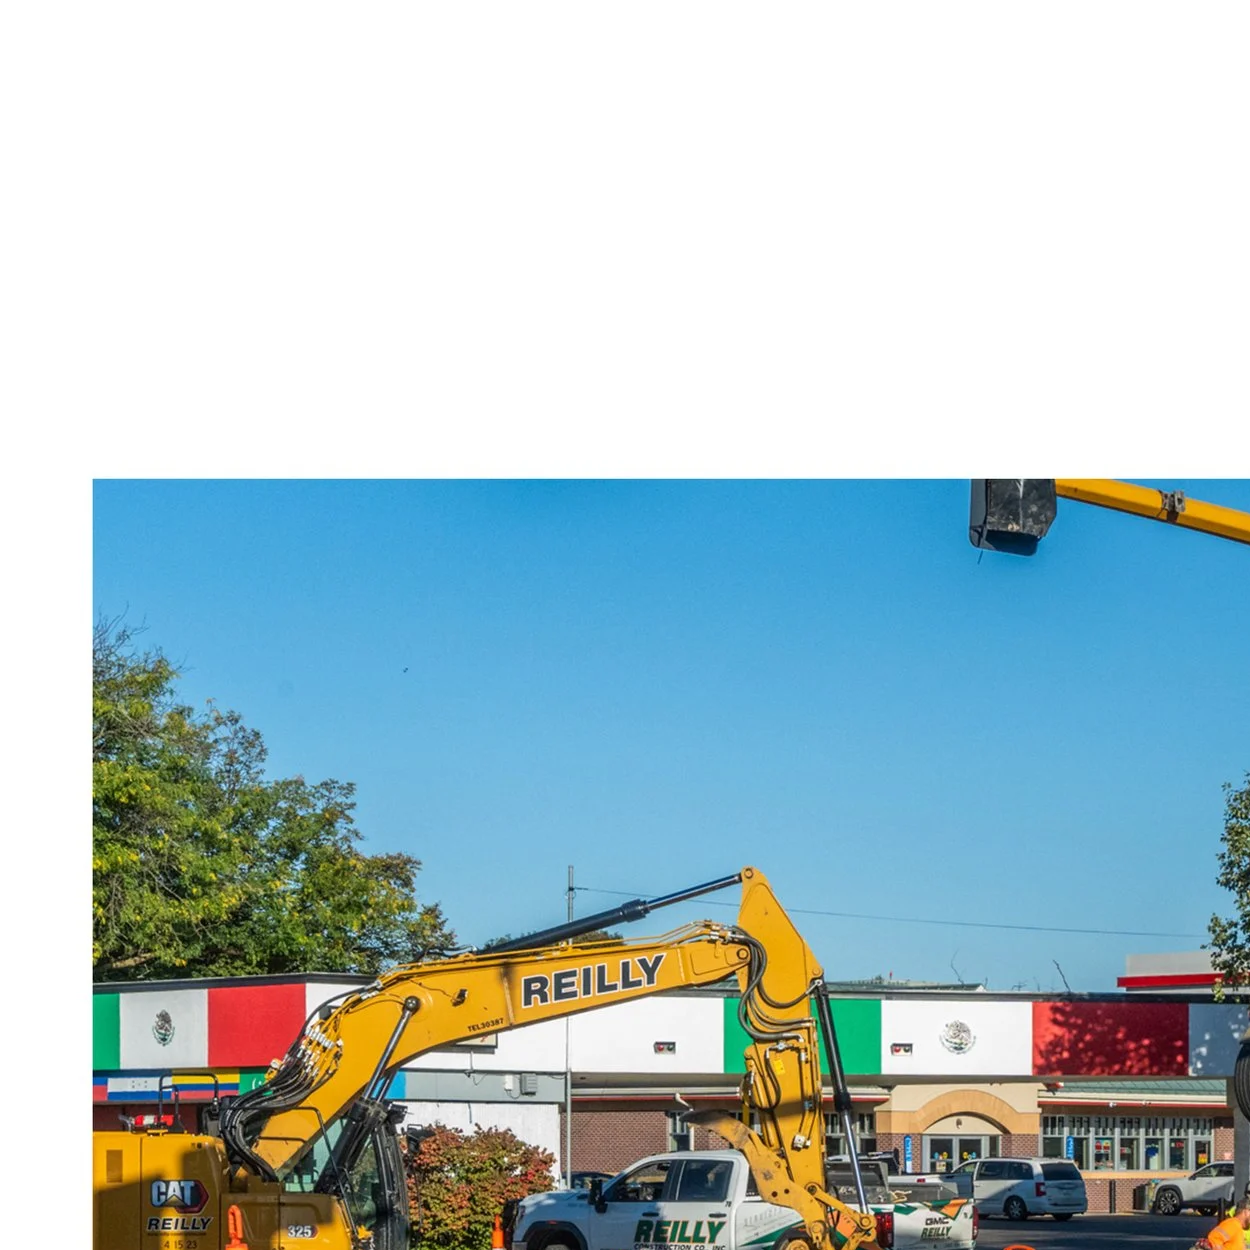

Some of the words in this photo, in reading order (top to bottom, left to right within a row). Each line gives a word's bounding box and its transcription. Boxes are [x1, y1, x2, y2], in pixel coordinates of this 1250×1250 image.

[522, 953, 667, 1008] REILLY
[467, 1018, 504, 1032] TEL30387
[151, 1180, 194, 1207] CAT
[148, 1217, 213, 1231] REILLY
[925, 1217, 949, 1226] GMC
[287, 1225, 312, 1237] 325
[634, 1220, 727, 1244] REILLY
[921, 1226, 952, 1238] REILLY
[174, 1240, 183, 1249] 15
[187, 1239, 198, 1249] 23
